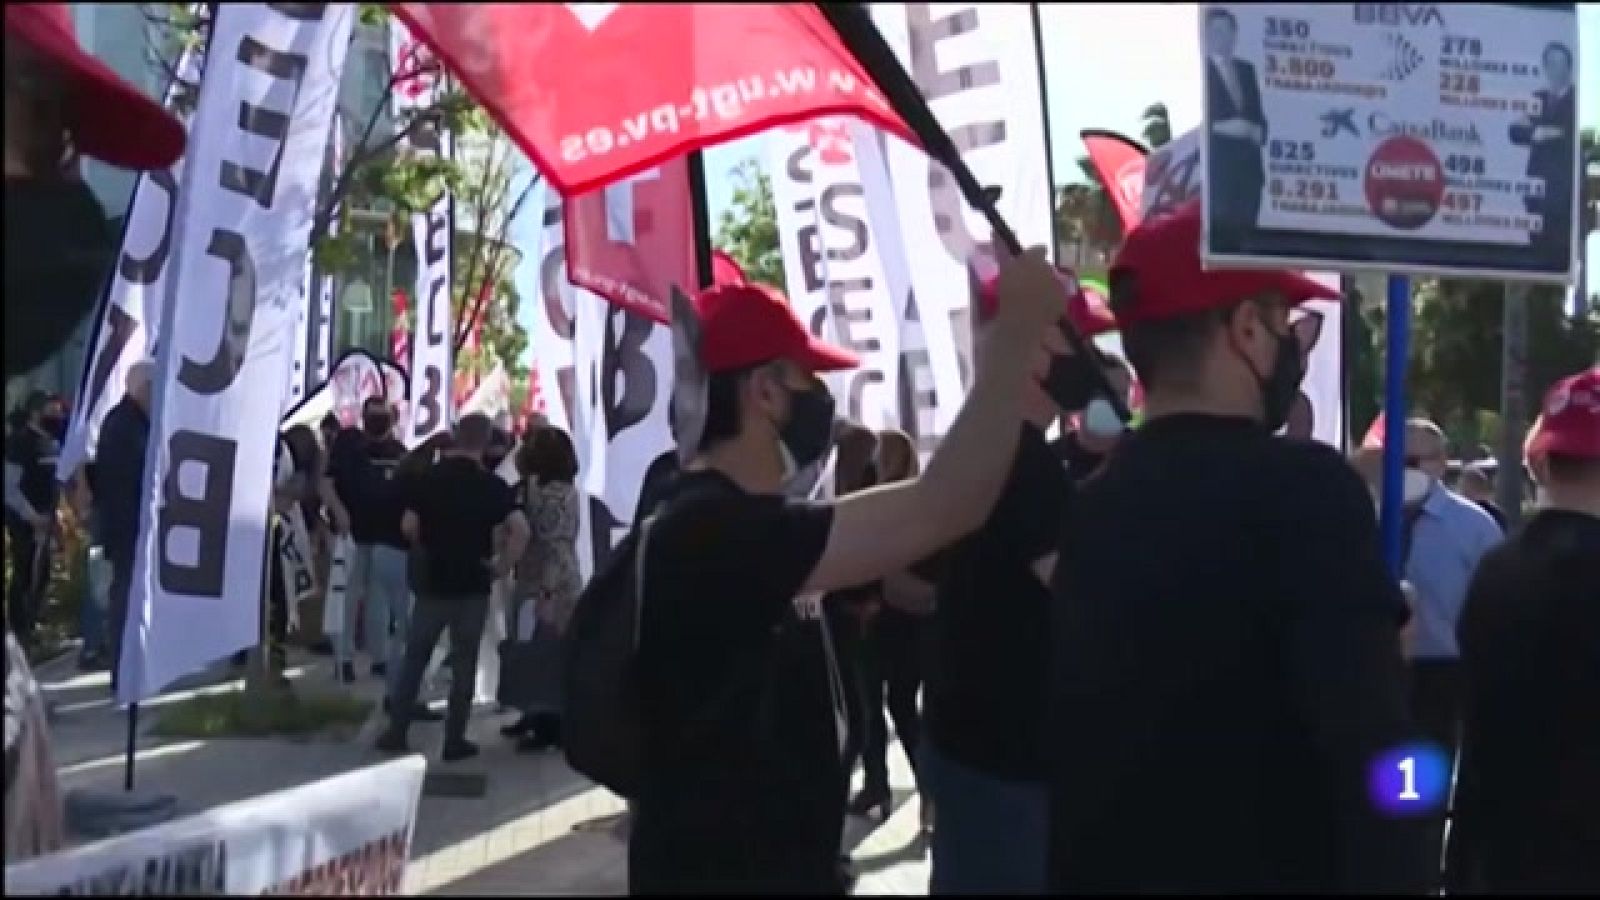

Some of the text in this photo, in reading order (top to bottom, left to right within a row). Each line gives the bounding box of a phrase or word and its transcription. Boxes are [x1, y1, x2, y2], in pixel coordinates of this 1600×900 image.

[1368, 113, 1481, 142] CaixaBank
[1270, 139, 1315, 161] 825
[1270, 179, 1339, 200] 8.291
